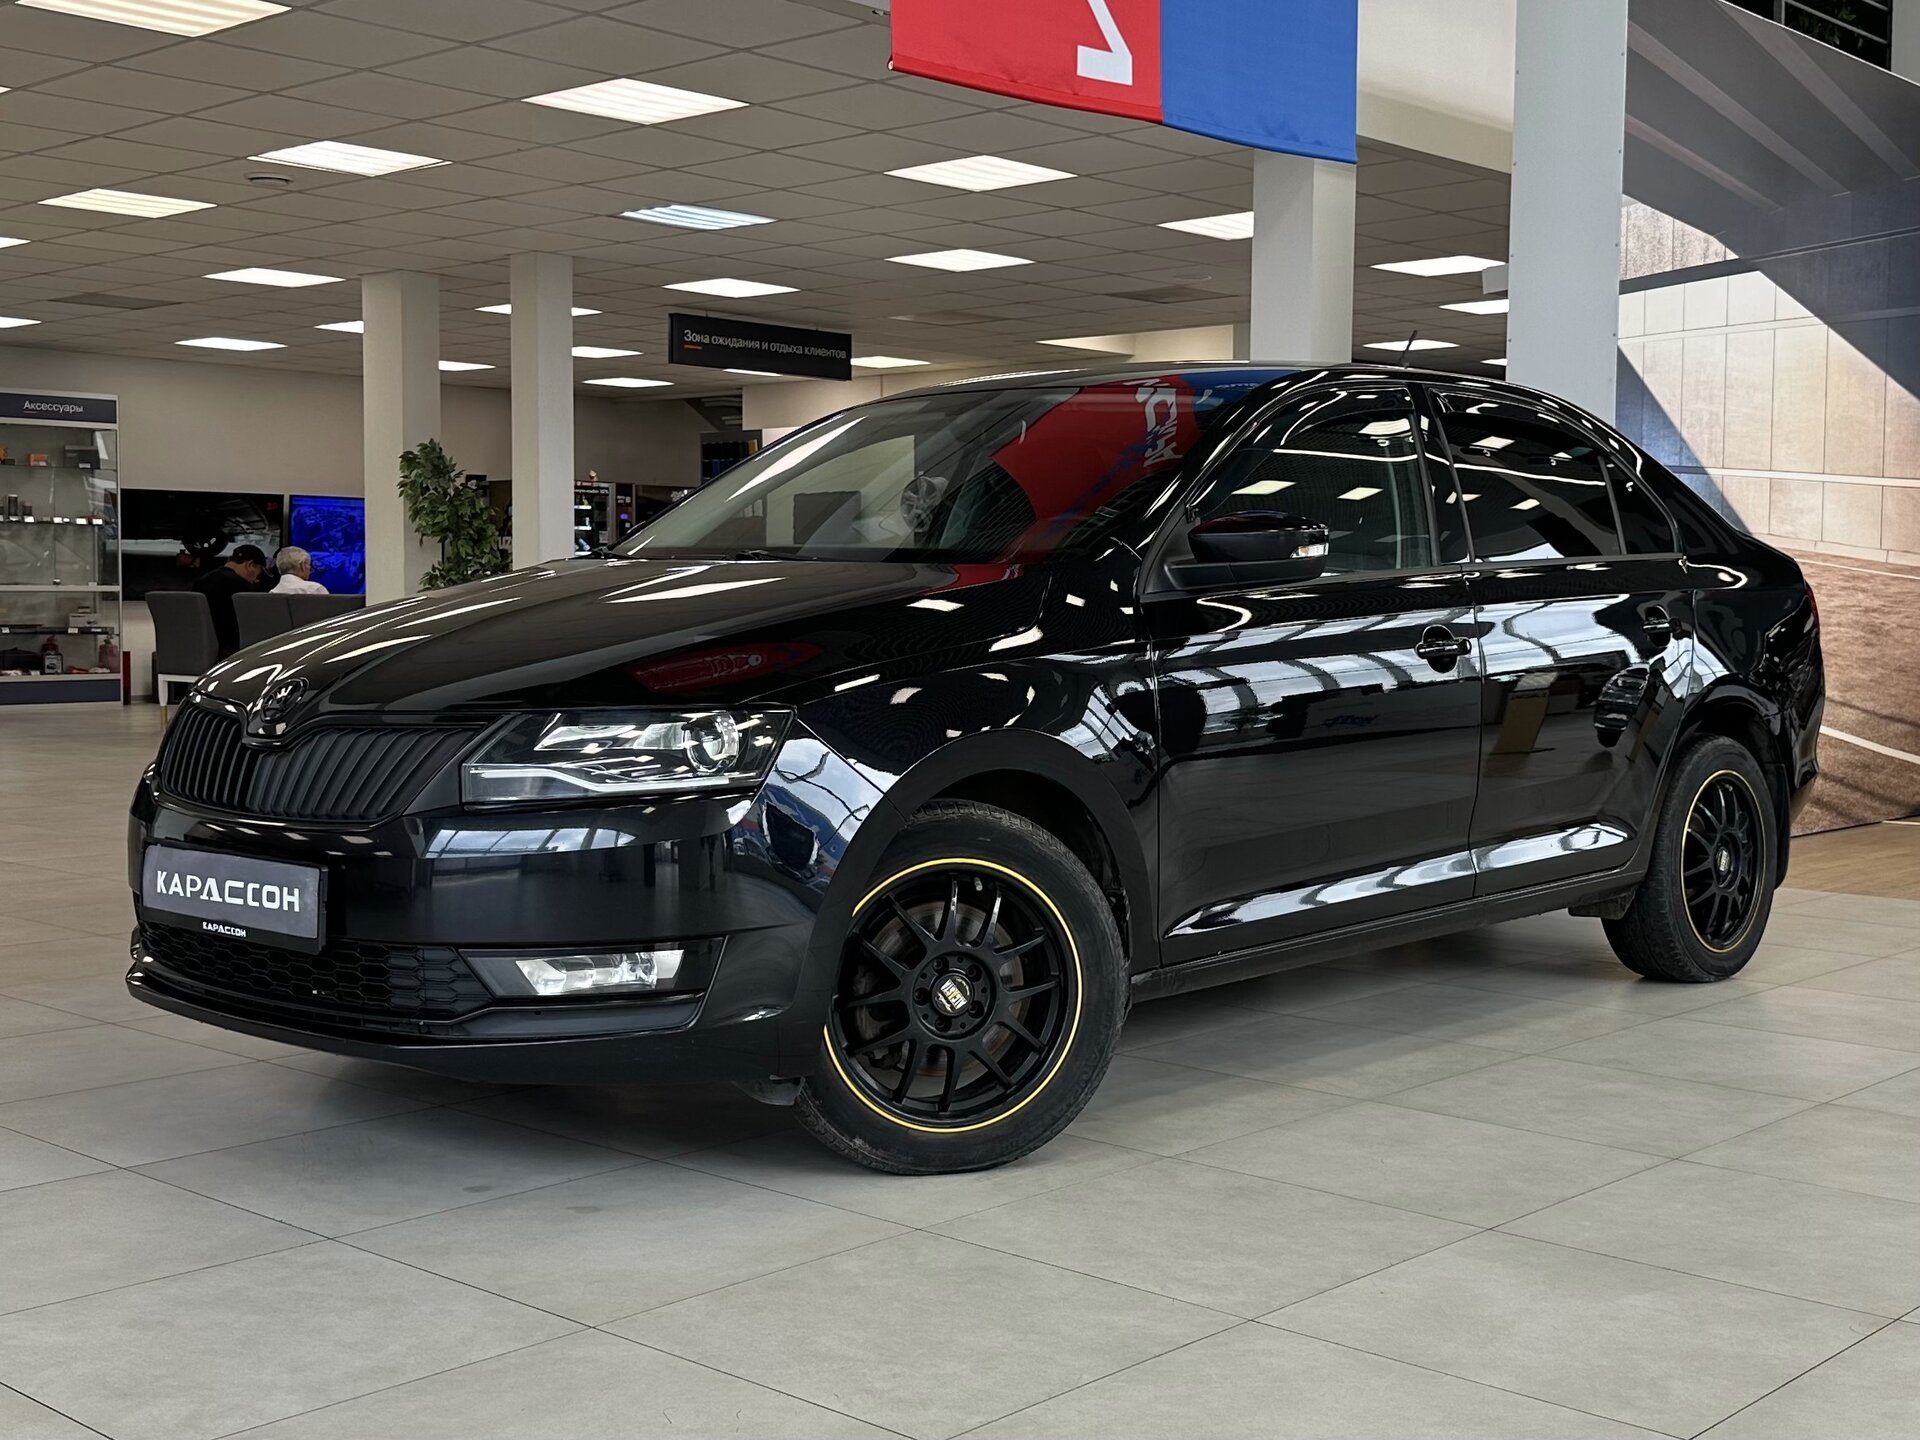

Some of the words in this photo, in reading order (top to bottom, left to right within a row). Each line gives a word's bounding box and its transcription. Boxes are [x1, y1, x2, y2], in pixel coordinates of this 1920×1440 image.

[684, 329, 710, 344] Зона
[711, 333, 760, 349] ожидания
[762, 342, 769, 351] и
[770, 342, 803, 354] отдыха
[805, 346, 847, 359] клиентов
[23, 400, 84, 414] Аксессуары
[156, 870, 300, 912] КАРАССОН
[202, 921, 247, 938] КАРАССОН
